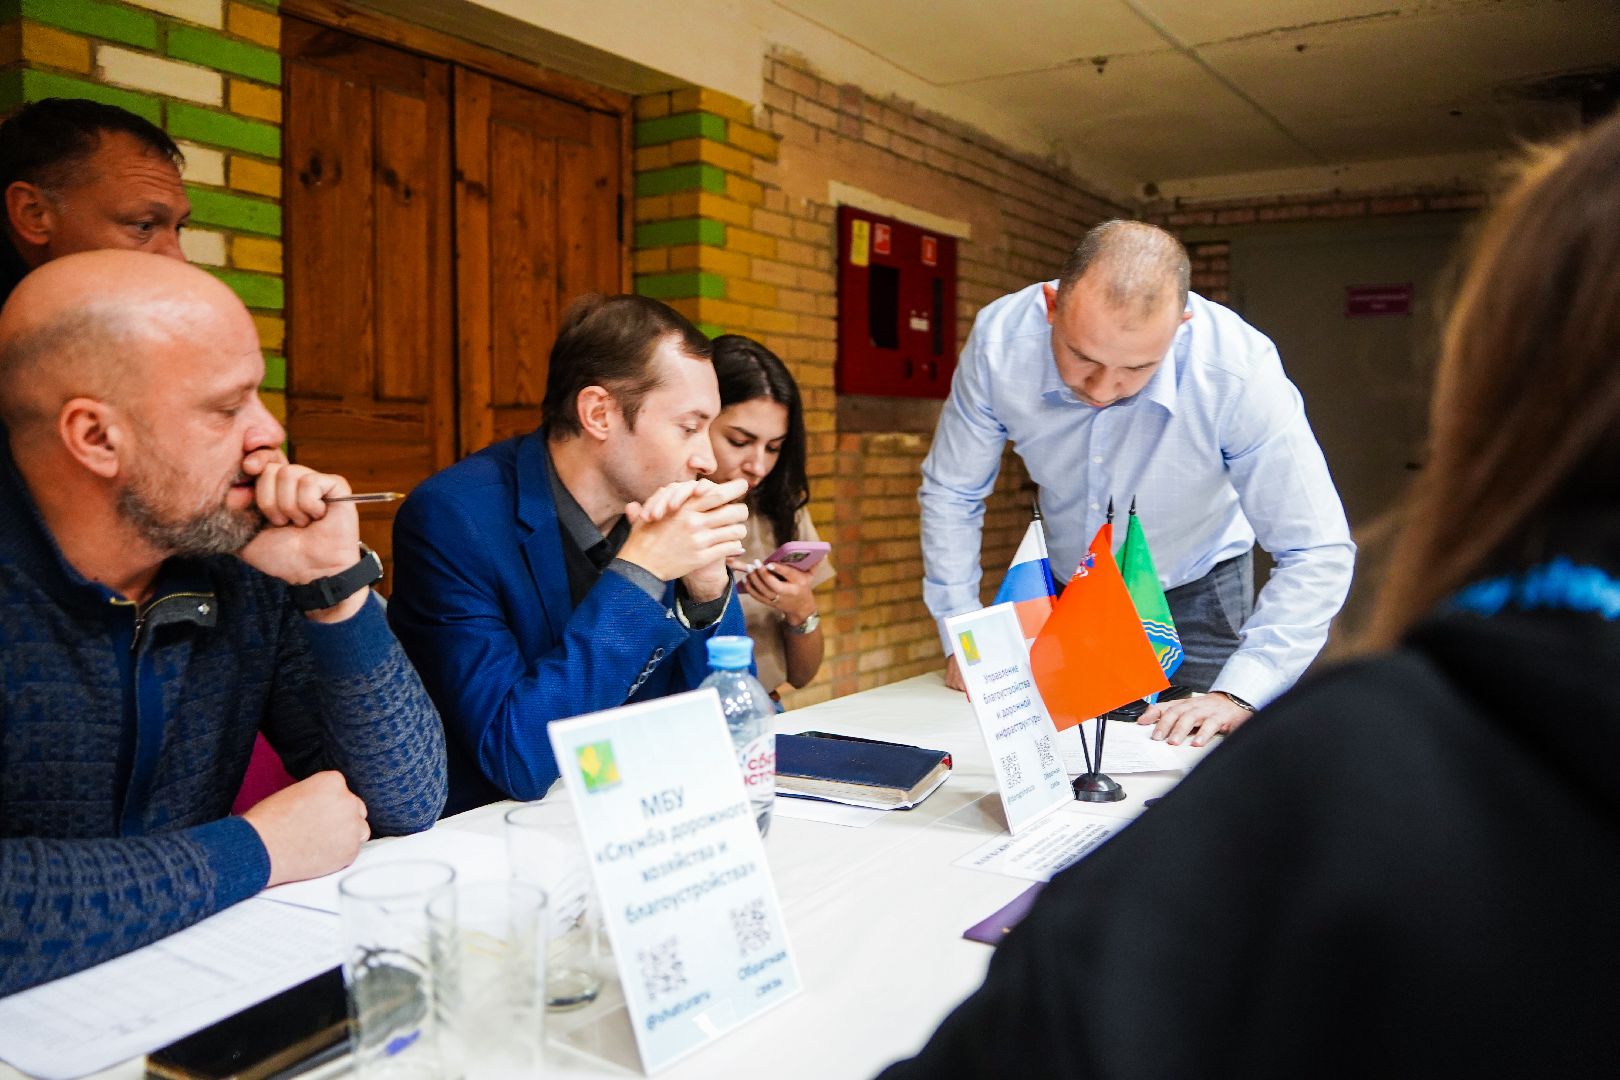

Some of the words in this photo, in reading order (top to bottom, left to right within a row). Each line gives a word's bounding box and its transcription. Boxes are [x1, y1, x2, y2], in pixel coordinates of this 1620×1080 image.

[983, 680, 1030, 704] благоустройства
[640, 785, 685, 819] МБУ
[717, 840, 729, 855] и
